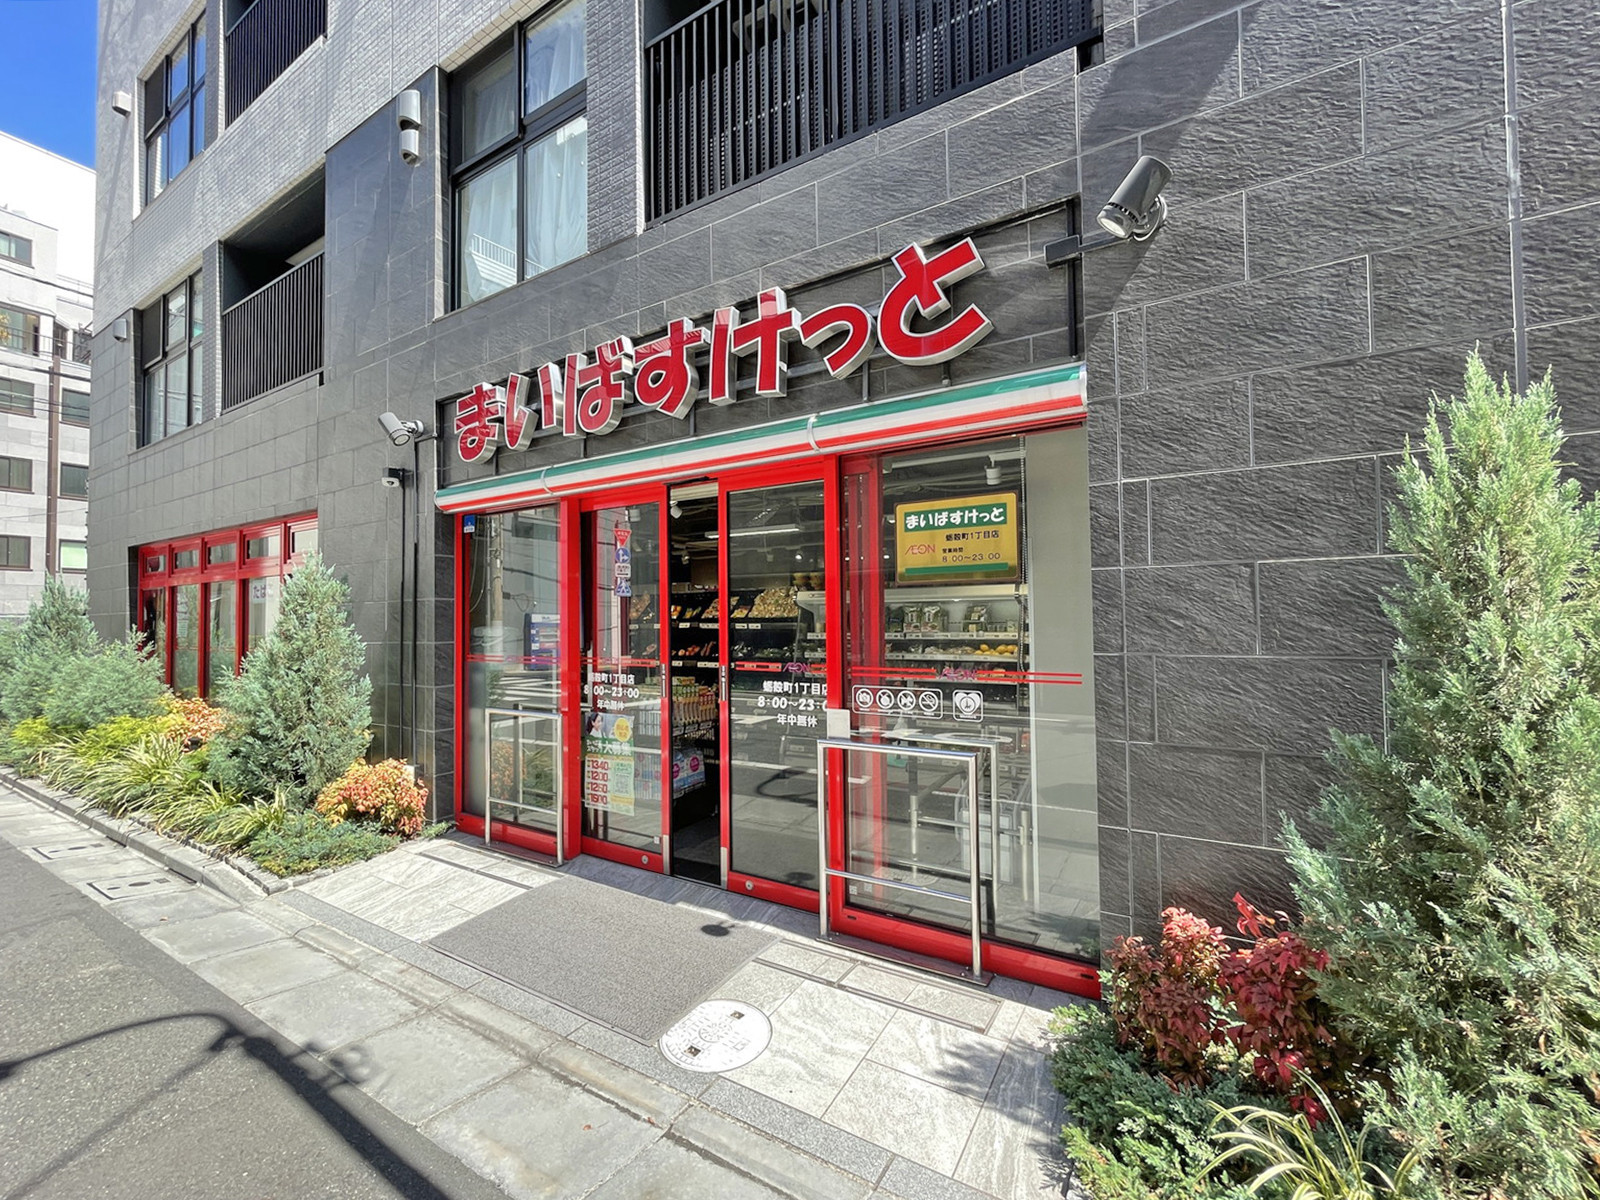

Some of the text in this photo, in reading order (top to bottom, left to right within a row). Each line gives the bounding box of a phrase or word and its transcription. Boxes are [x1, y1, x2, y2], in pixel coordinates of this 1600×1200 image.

[454, 237, 992, 464] まいばすけっと
[906, 507, 1004, 529] まいばすけっと
[777, 713, 818, 727] 年中無休
